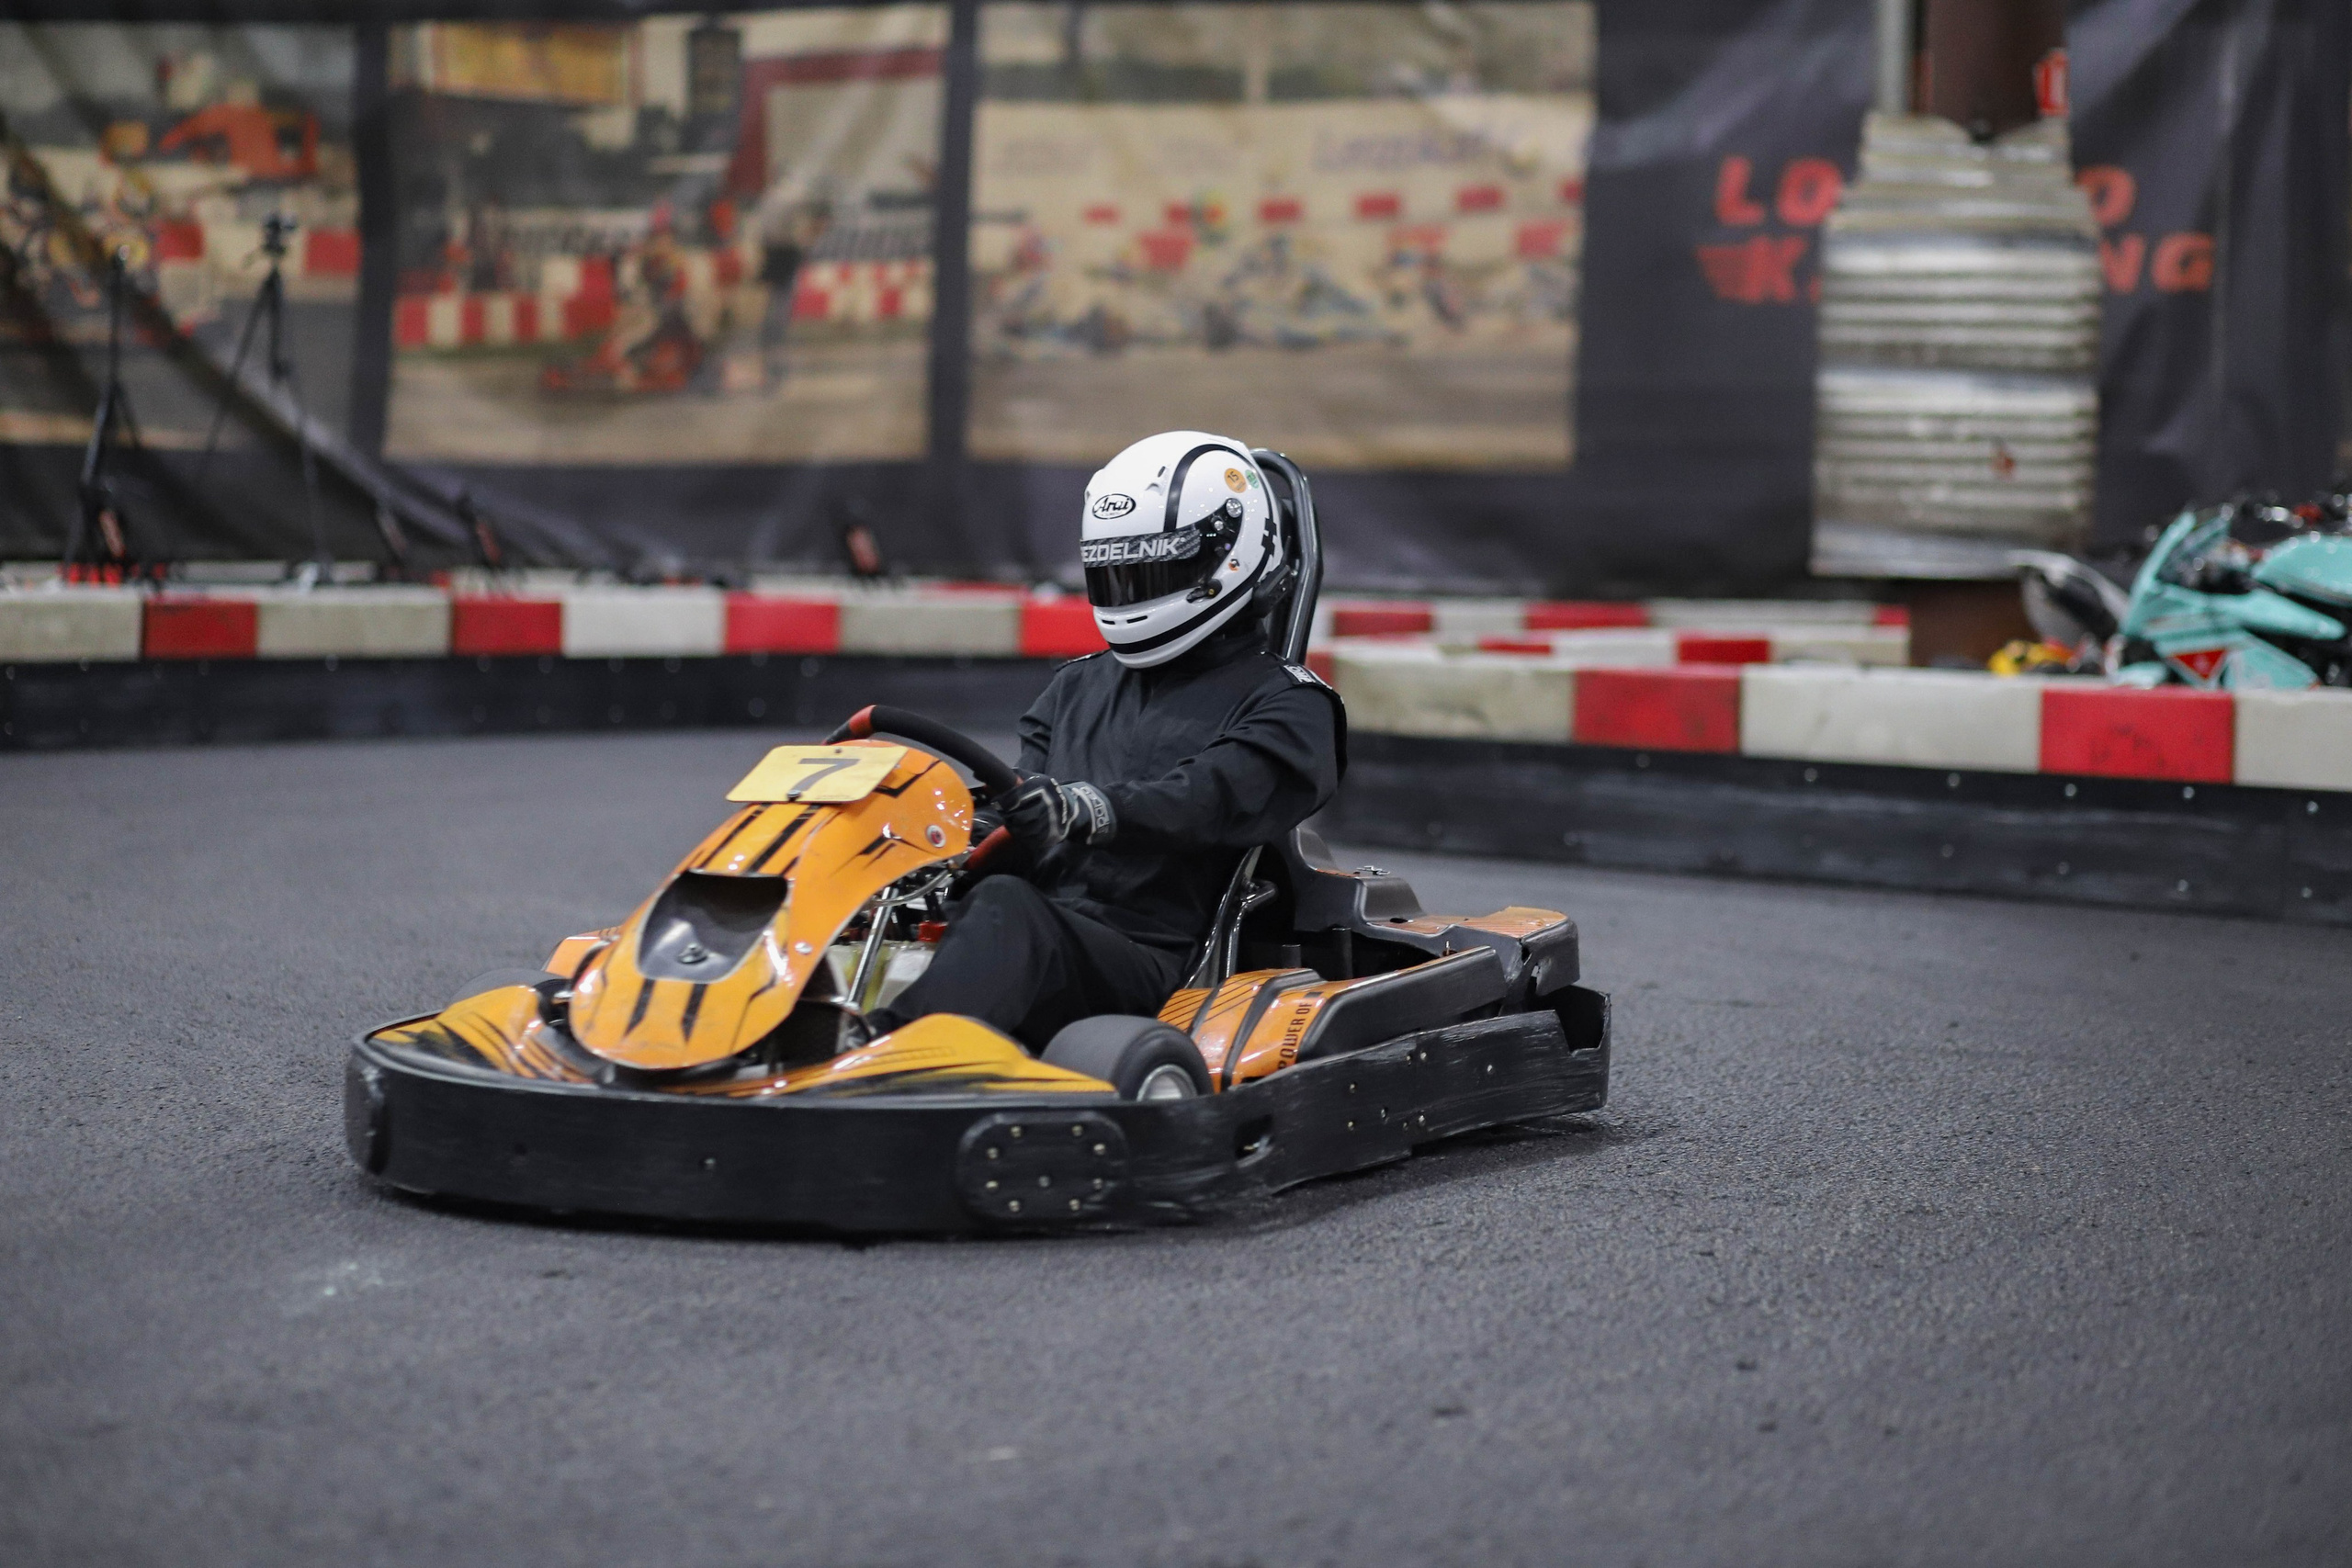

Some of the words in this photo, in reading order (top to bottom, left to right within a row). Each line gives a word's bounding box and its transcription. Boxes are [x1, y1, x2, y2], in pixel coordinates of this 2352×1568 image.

[1094, 496, 1131, 514] Arai
[792, 758, 861, 792] 7
[1278, 1018, 1306, 1069] POWER
